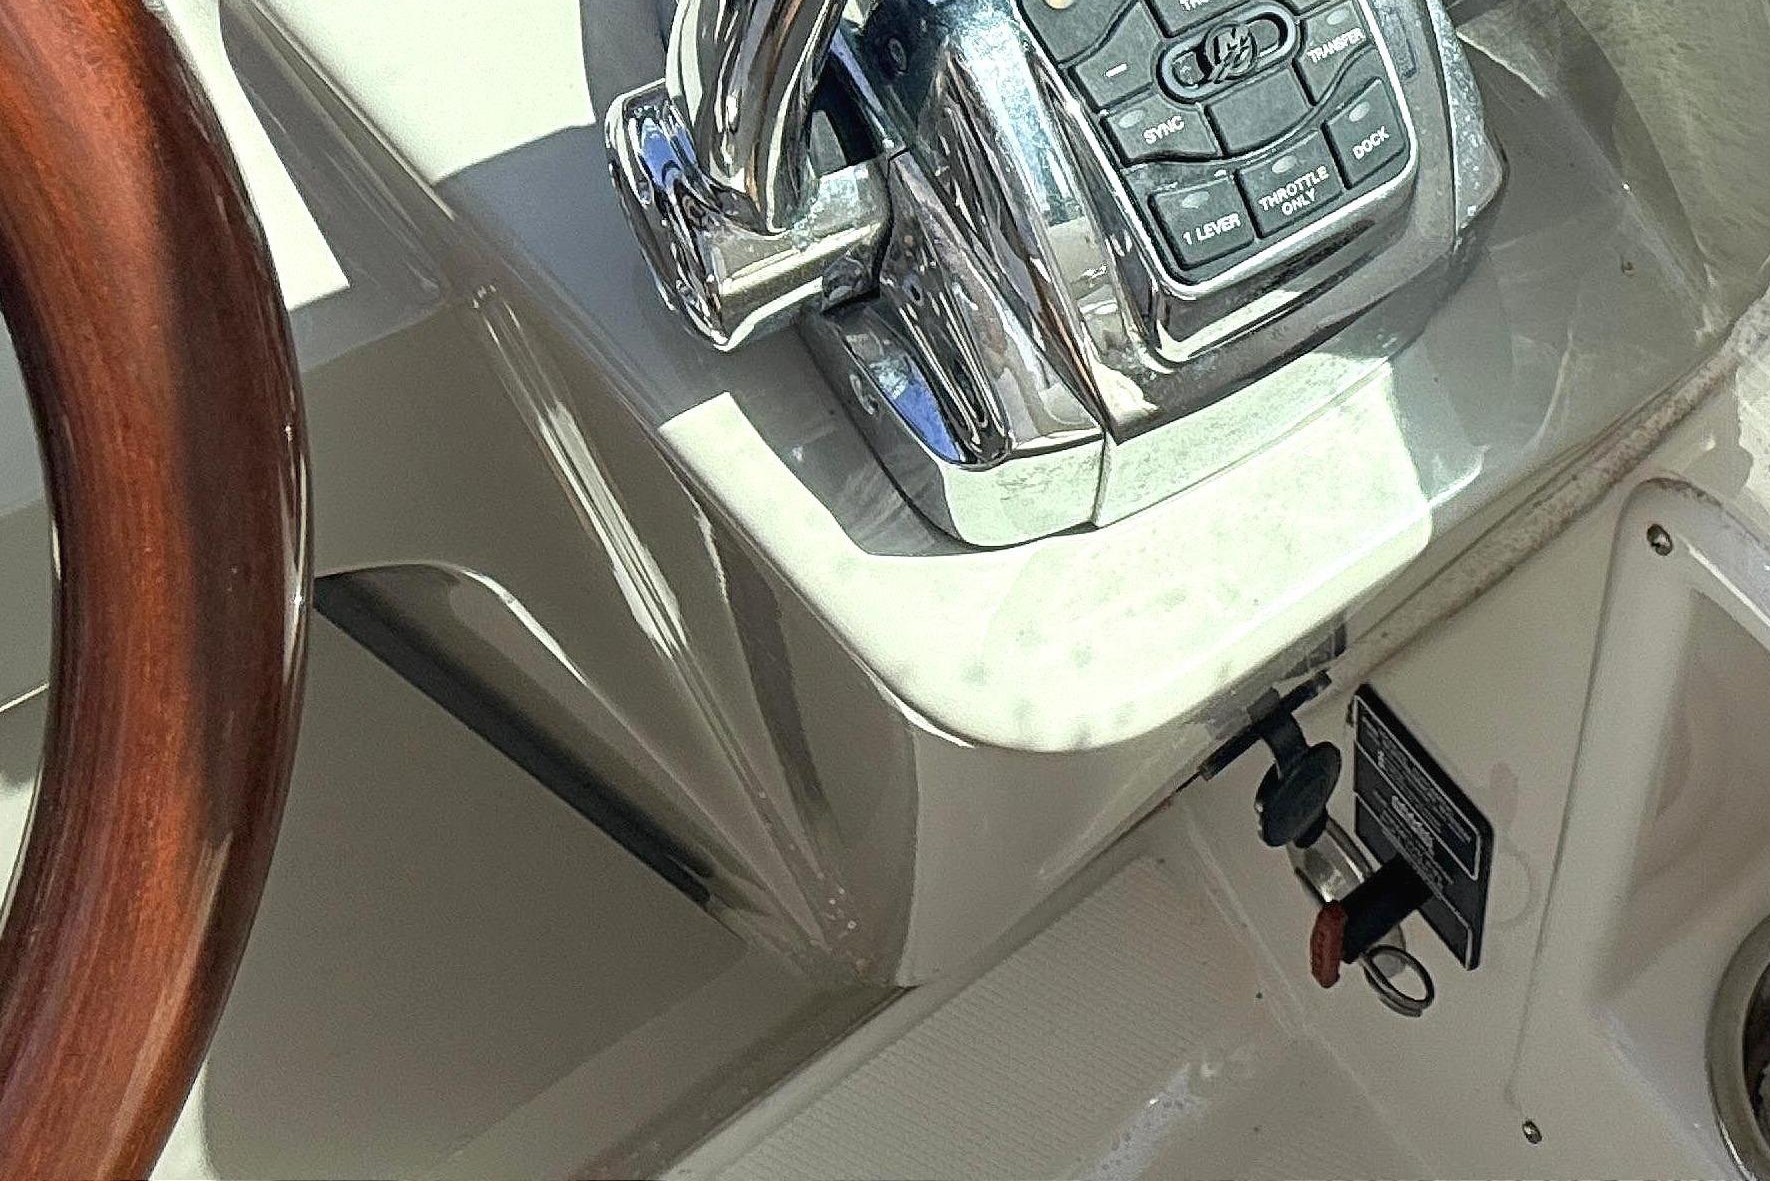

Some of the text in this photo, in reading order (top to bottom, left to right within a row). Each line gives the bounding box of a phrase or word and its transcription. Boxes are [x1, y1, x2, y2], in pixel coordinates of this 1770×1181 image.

[1306, 27, 1367, 65] TRANSFER
[1143, 115, 1186, 146] SYNC
[1352, 127, 1390, 160] DOCK
[1258, 167, 1331, 214] THROTTLE
[1281, 188, 1319, 217] ONLY
[1183, 213, 1243, 247] 1 LEVER
